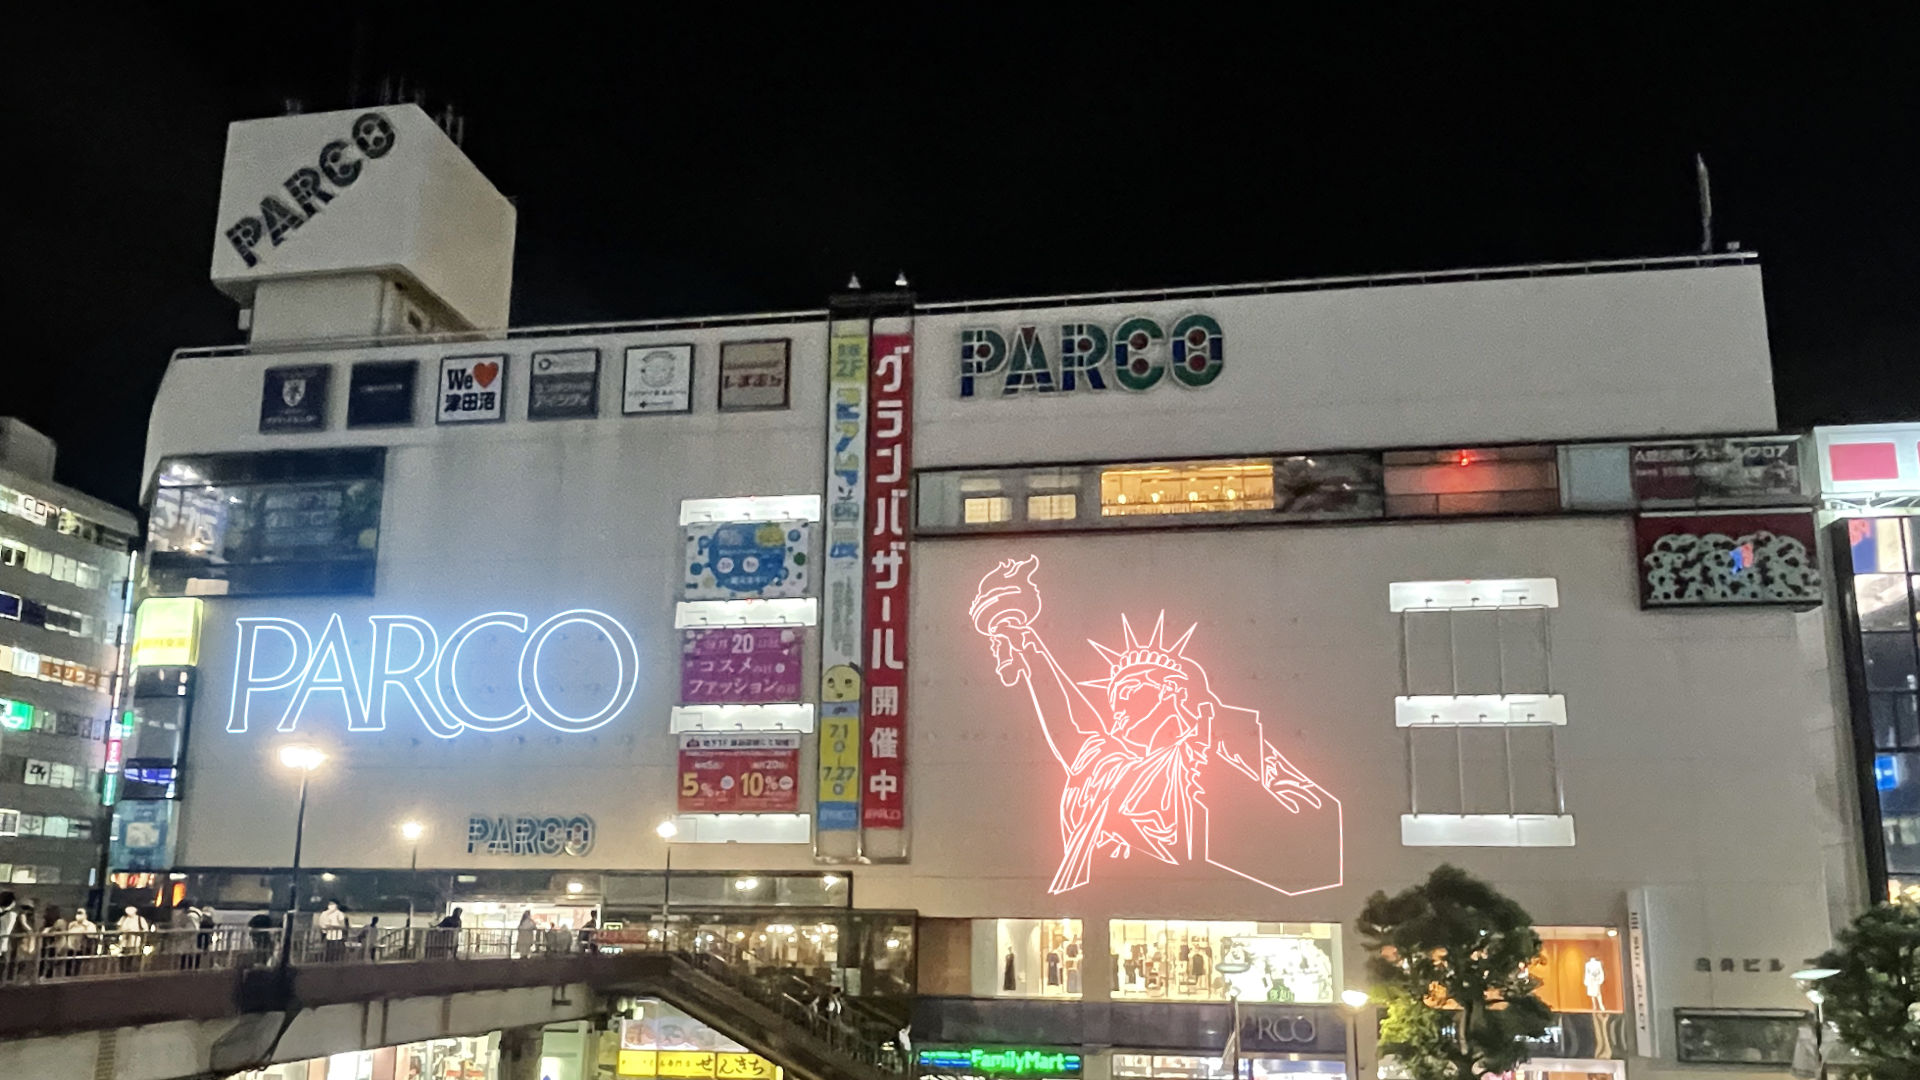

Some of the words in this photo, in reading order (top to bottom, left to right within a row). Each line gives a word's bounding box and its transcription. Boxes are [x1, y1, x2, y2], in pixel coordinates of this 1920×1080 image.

[225, 112, 395, 267] PARCO
[960, 314, 1224, 398] PARCO
[447, 368, 473, 390] We
[444, 391, 496, 412] 津田沼
[226, 608, 640, 739] PARCO
[467, 813, 597, 858] PARCO
[696, 1055, 766, 1075] せんきち
[970, 1049, 1066, 1073] FamilyMart
